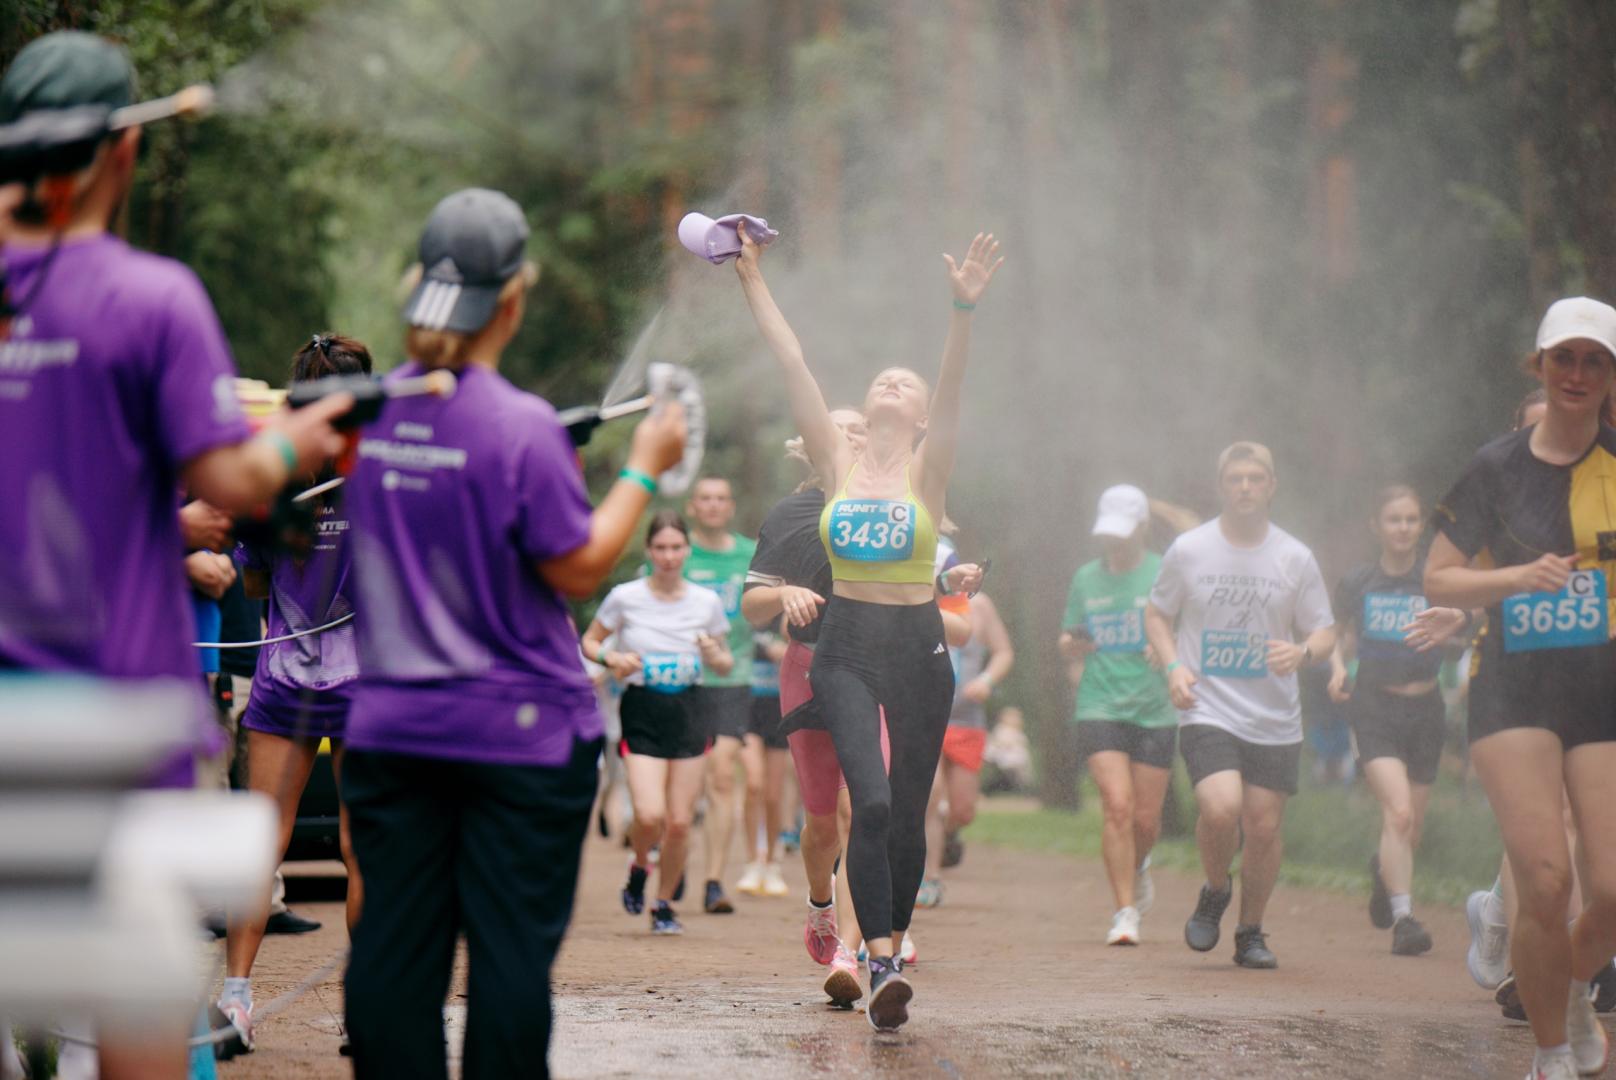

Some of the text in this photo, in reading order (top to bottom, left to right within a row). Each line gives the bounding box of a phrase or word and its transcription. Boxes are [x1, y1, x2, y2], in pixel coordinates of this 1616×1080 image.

[837, 504, 878, 513] RUNIT
[891, 505, 907, 522] C
[834, 521, 908, 549] 3436
[1572, 574, 1591, 595] C
[1208, 588, 1272, 609] RUN
[1510, 597, 1601, 635] 3655
[1205, 646, 1265, 669] 2072
